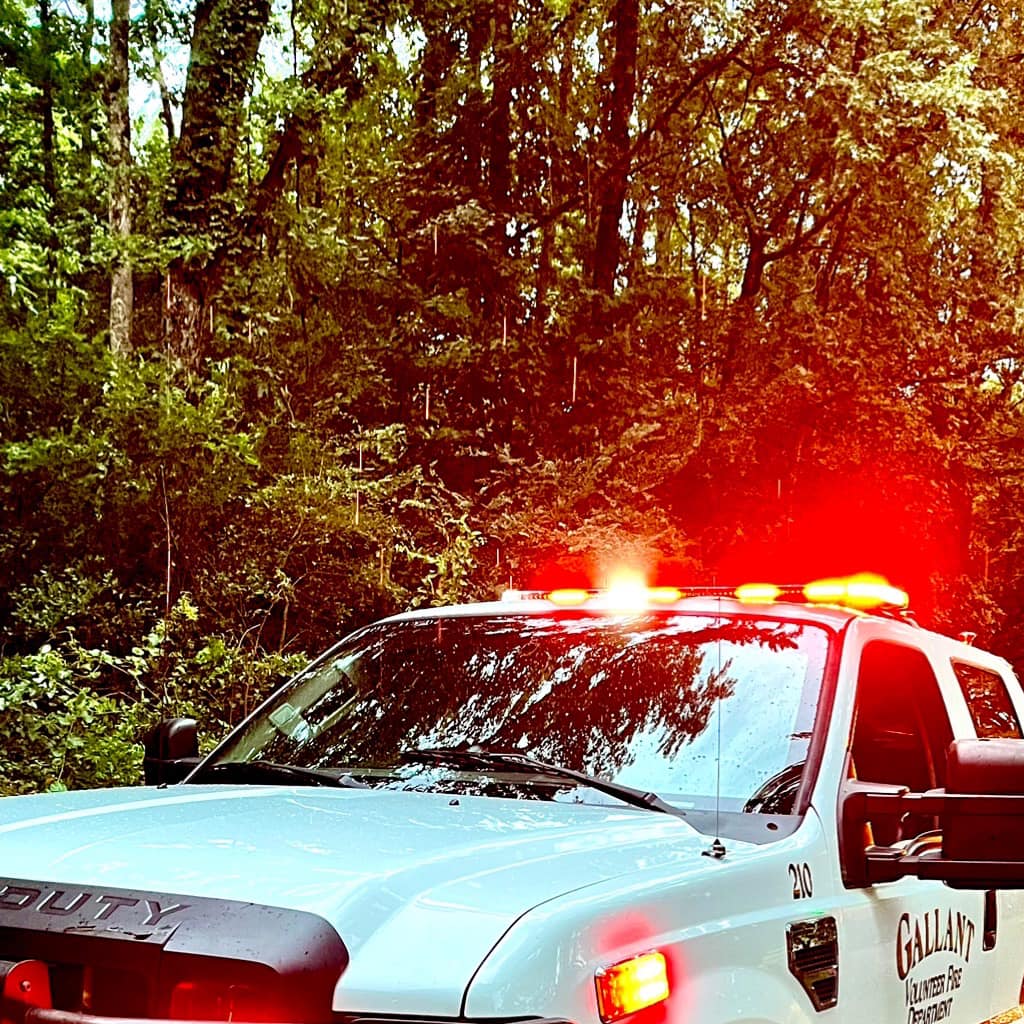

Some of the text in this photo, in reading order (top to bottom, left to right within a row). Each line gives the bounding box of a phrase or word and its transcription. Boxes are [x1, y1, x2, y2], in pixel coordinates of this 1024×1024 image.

[788, 862, 813, 900] 210
[0, 885, 190, 926] DUTY
[896, 908, 975, 981] GALLANT
[906, 965, 963, 1007] VOLUNTEER FIRE
